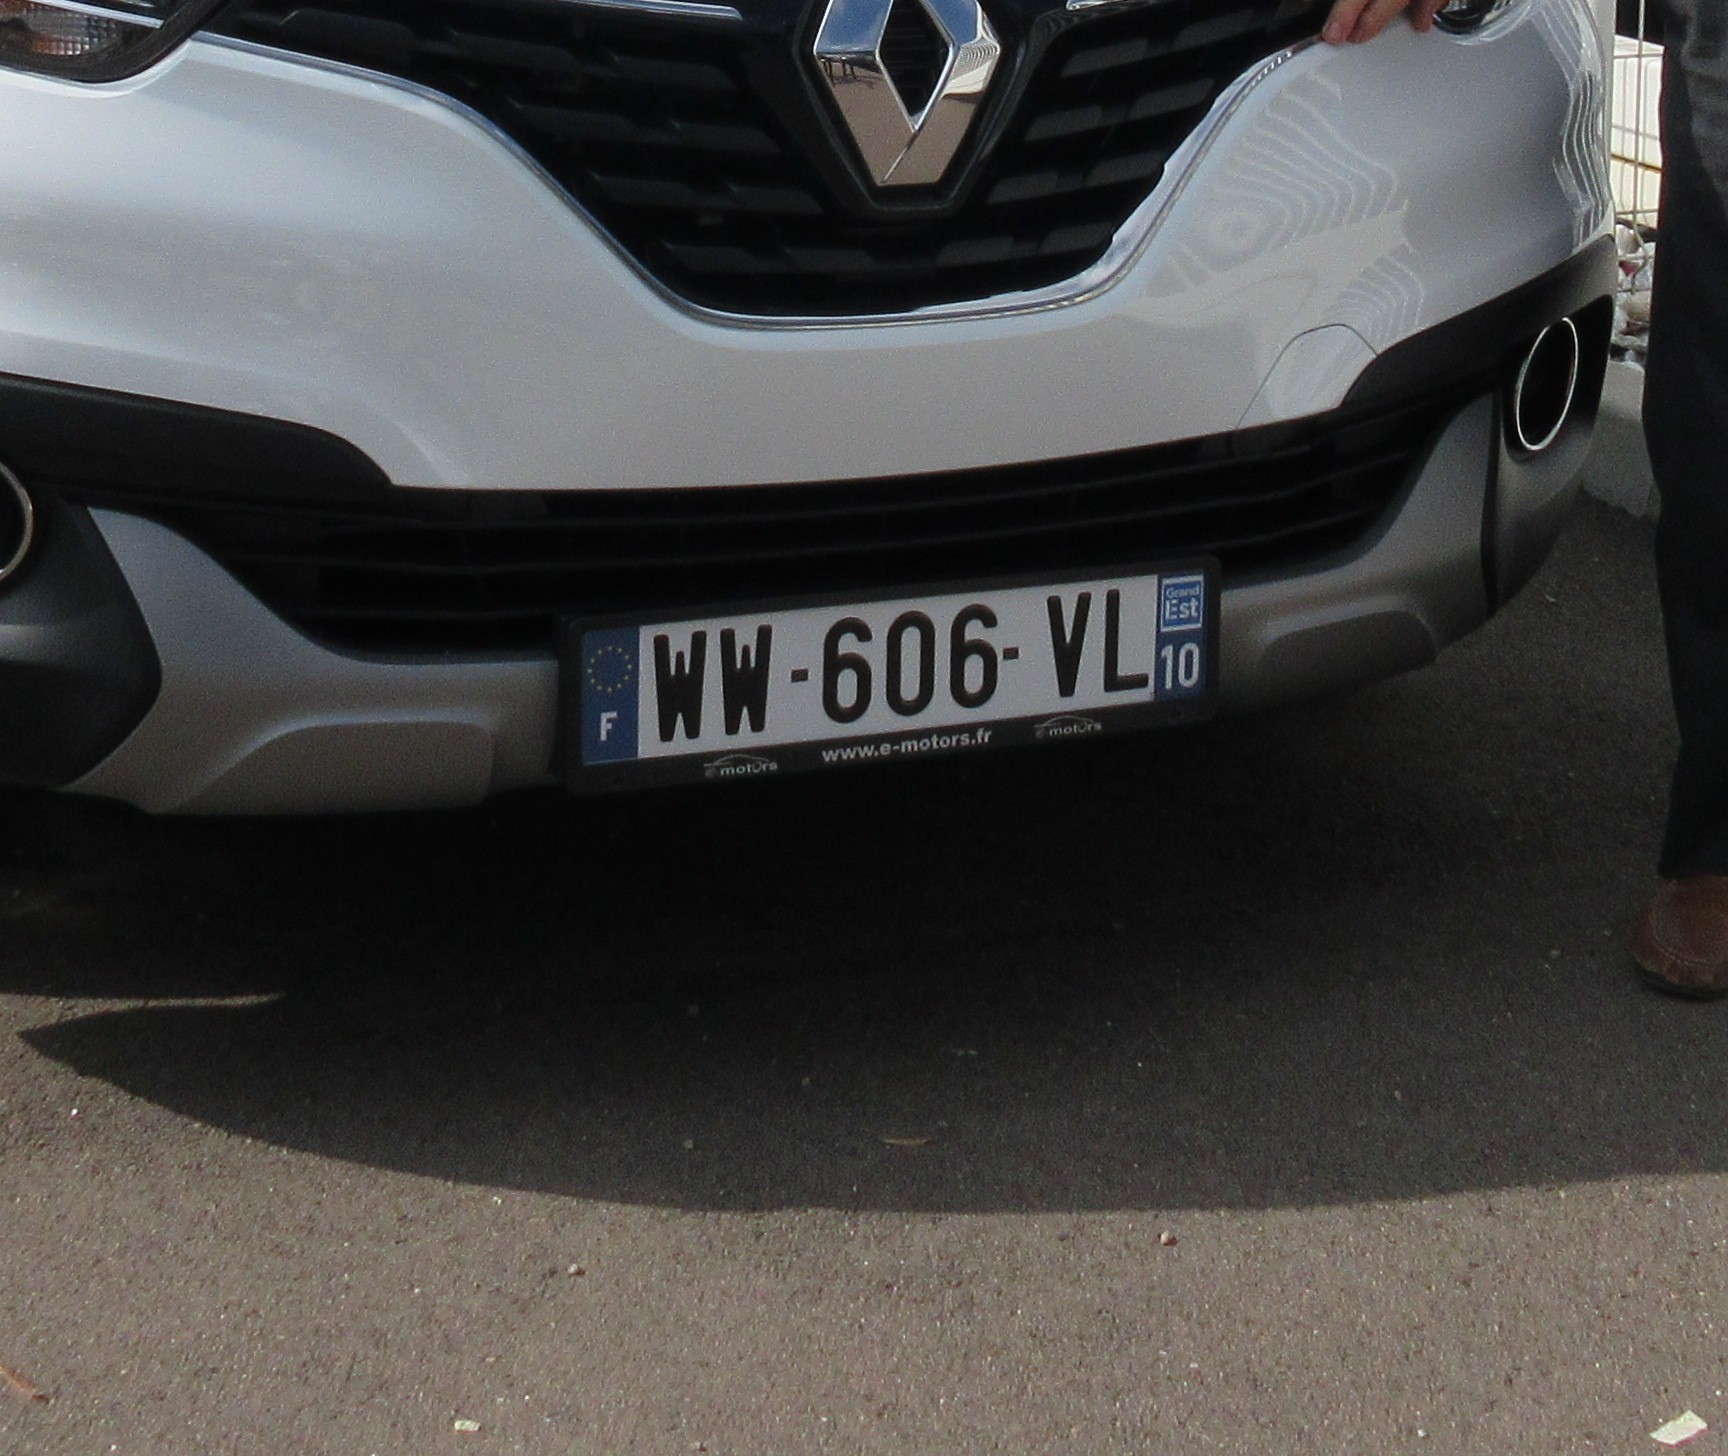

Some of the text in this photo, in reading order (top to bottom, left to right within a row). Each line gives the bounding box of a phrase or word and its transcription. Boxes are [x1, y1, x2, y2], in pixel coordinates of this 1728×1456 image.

[1165, 597, 1200, 620] Est
[1161, 642, 1200, 690] 10
[600, 711, 618, 742] F
[822, 727, 992, 763] www.e-motors.fr
